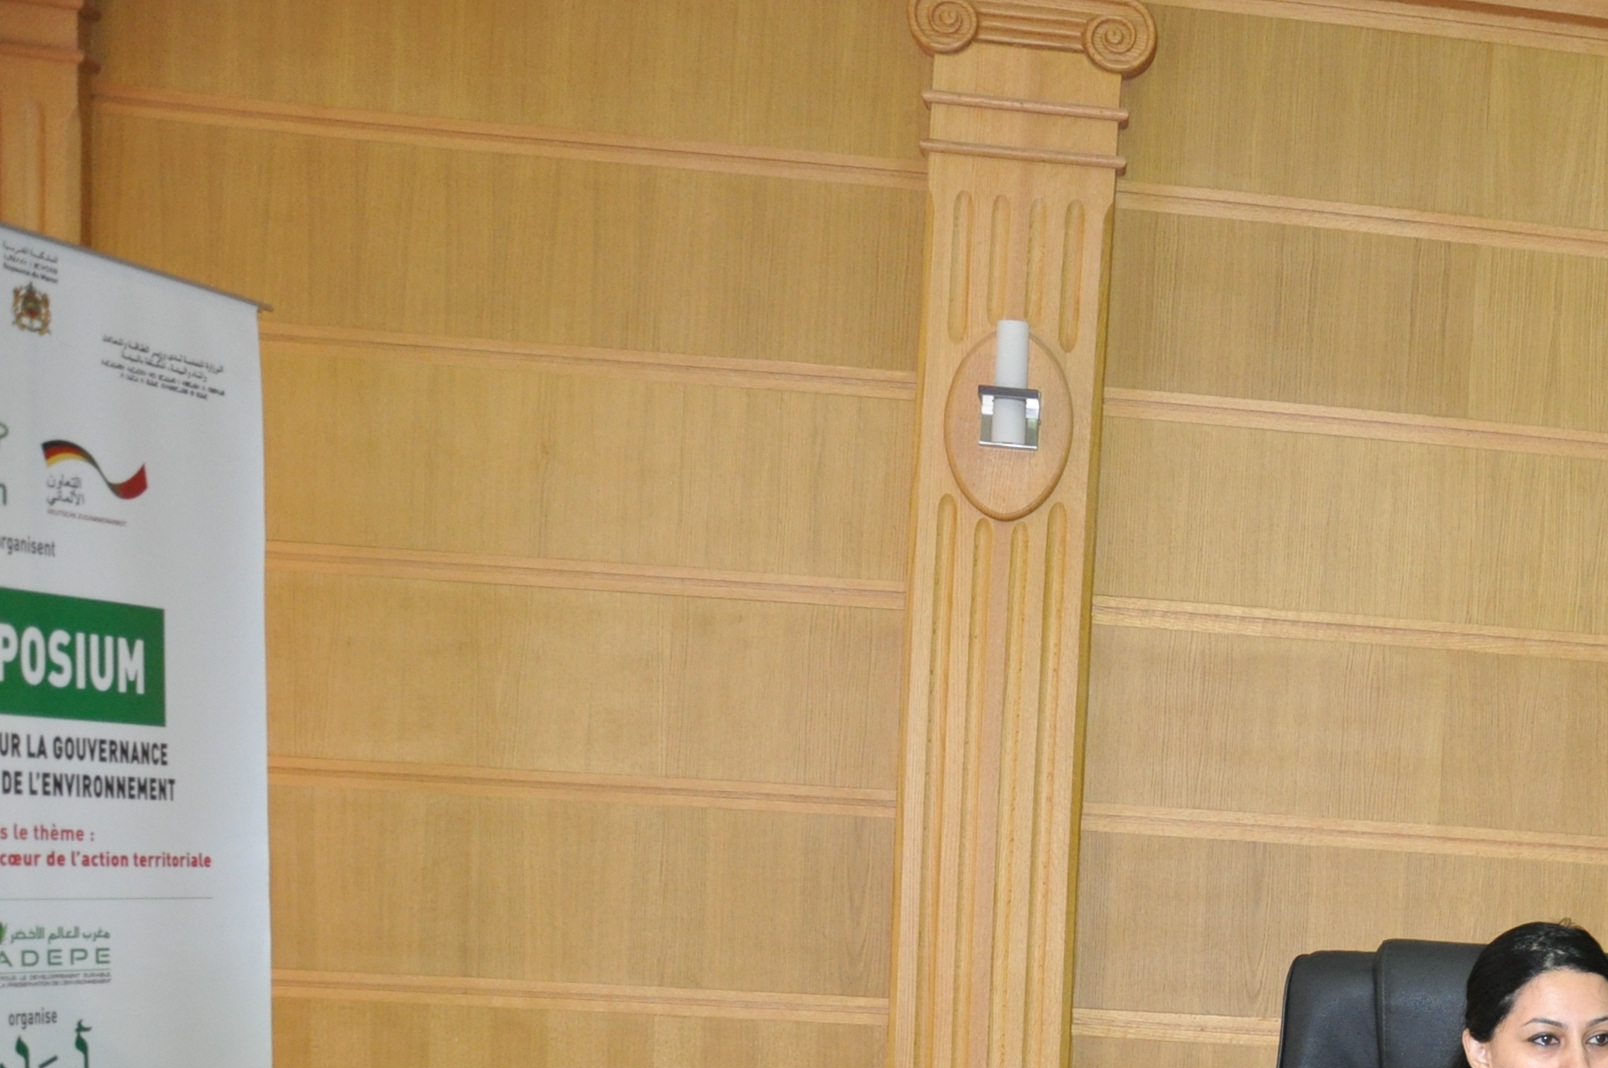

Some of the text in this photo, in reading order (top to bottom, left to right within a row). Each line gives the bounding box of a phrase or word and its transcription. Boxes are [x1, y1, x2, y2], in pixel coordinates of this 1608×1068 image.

[0, 535, 55, 557] rganisent
[0, 622, 145, 695] POSIUM
[26, 734, 48, 759] LA
[53, 736, 168, 766] GOUVERNANCE
[2, 770, 175, 801] DE L'ENVIRONNEMENT
[13, 824, 28, 840] le
[33, 823, 85, 842] thème
[46, 851, 66, 867] de
[71, 851, 129, 868] l'action
[133, 852, 212, 868] territoriale
[8, 1007, 57, 1030] organise
